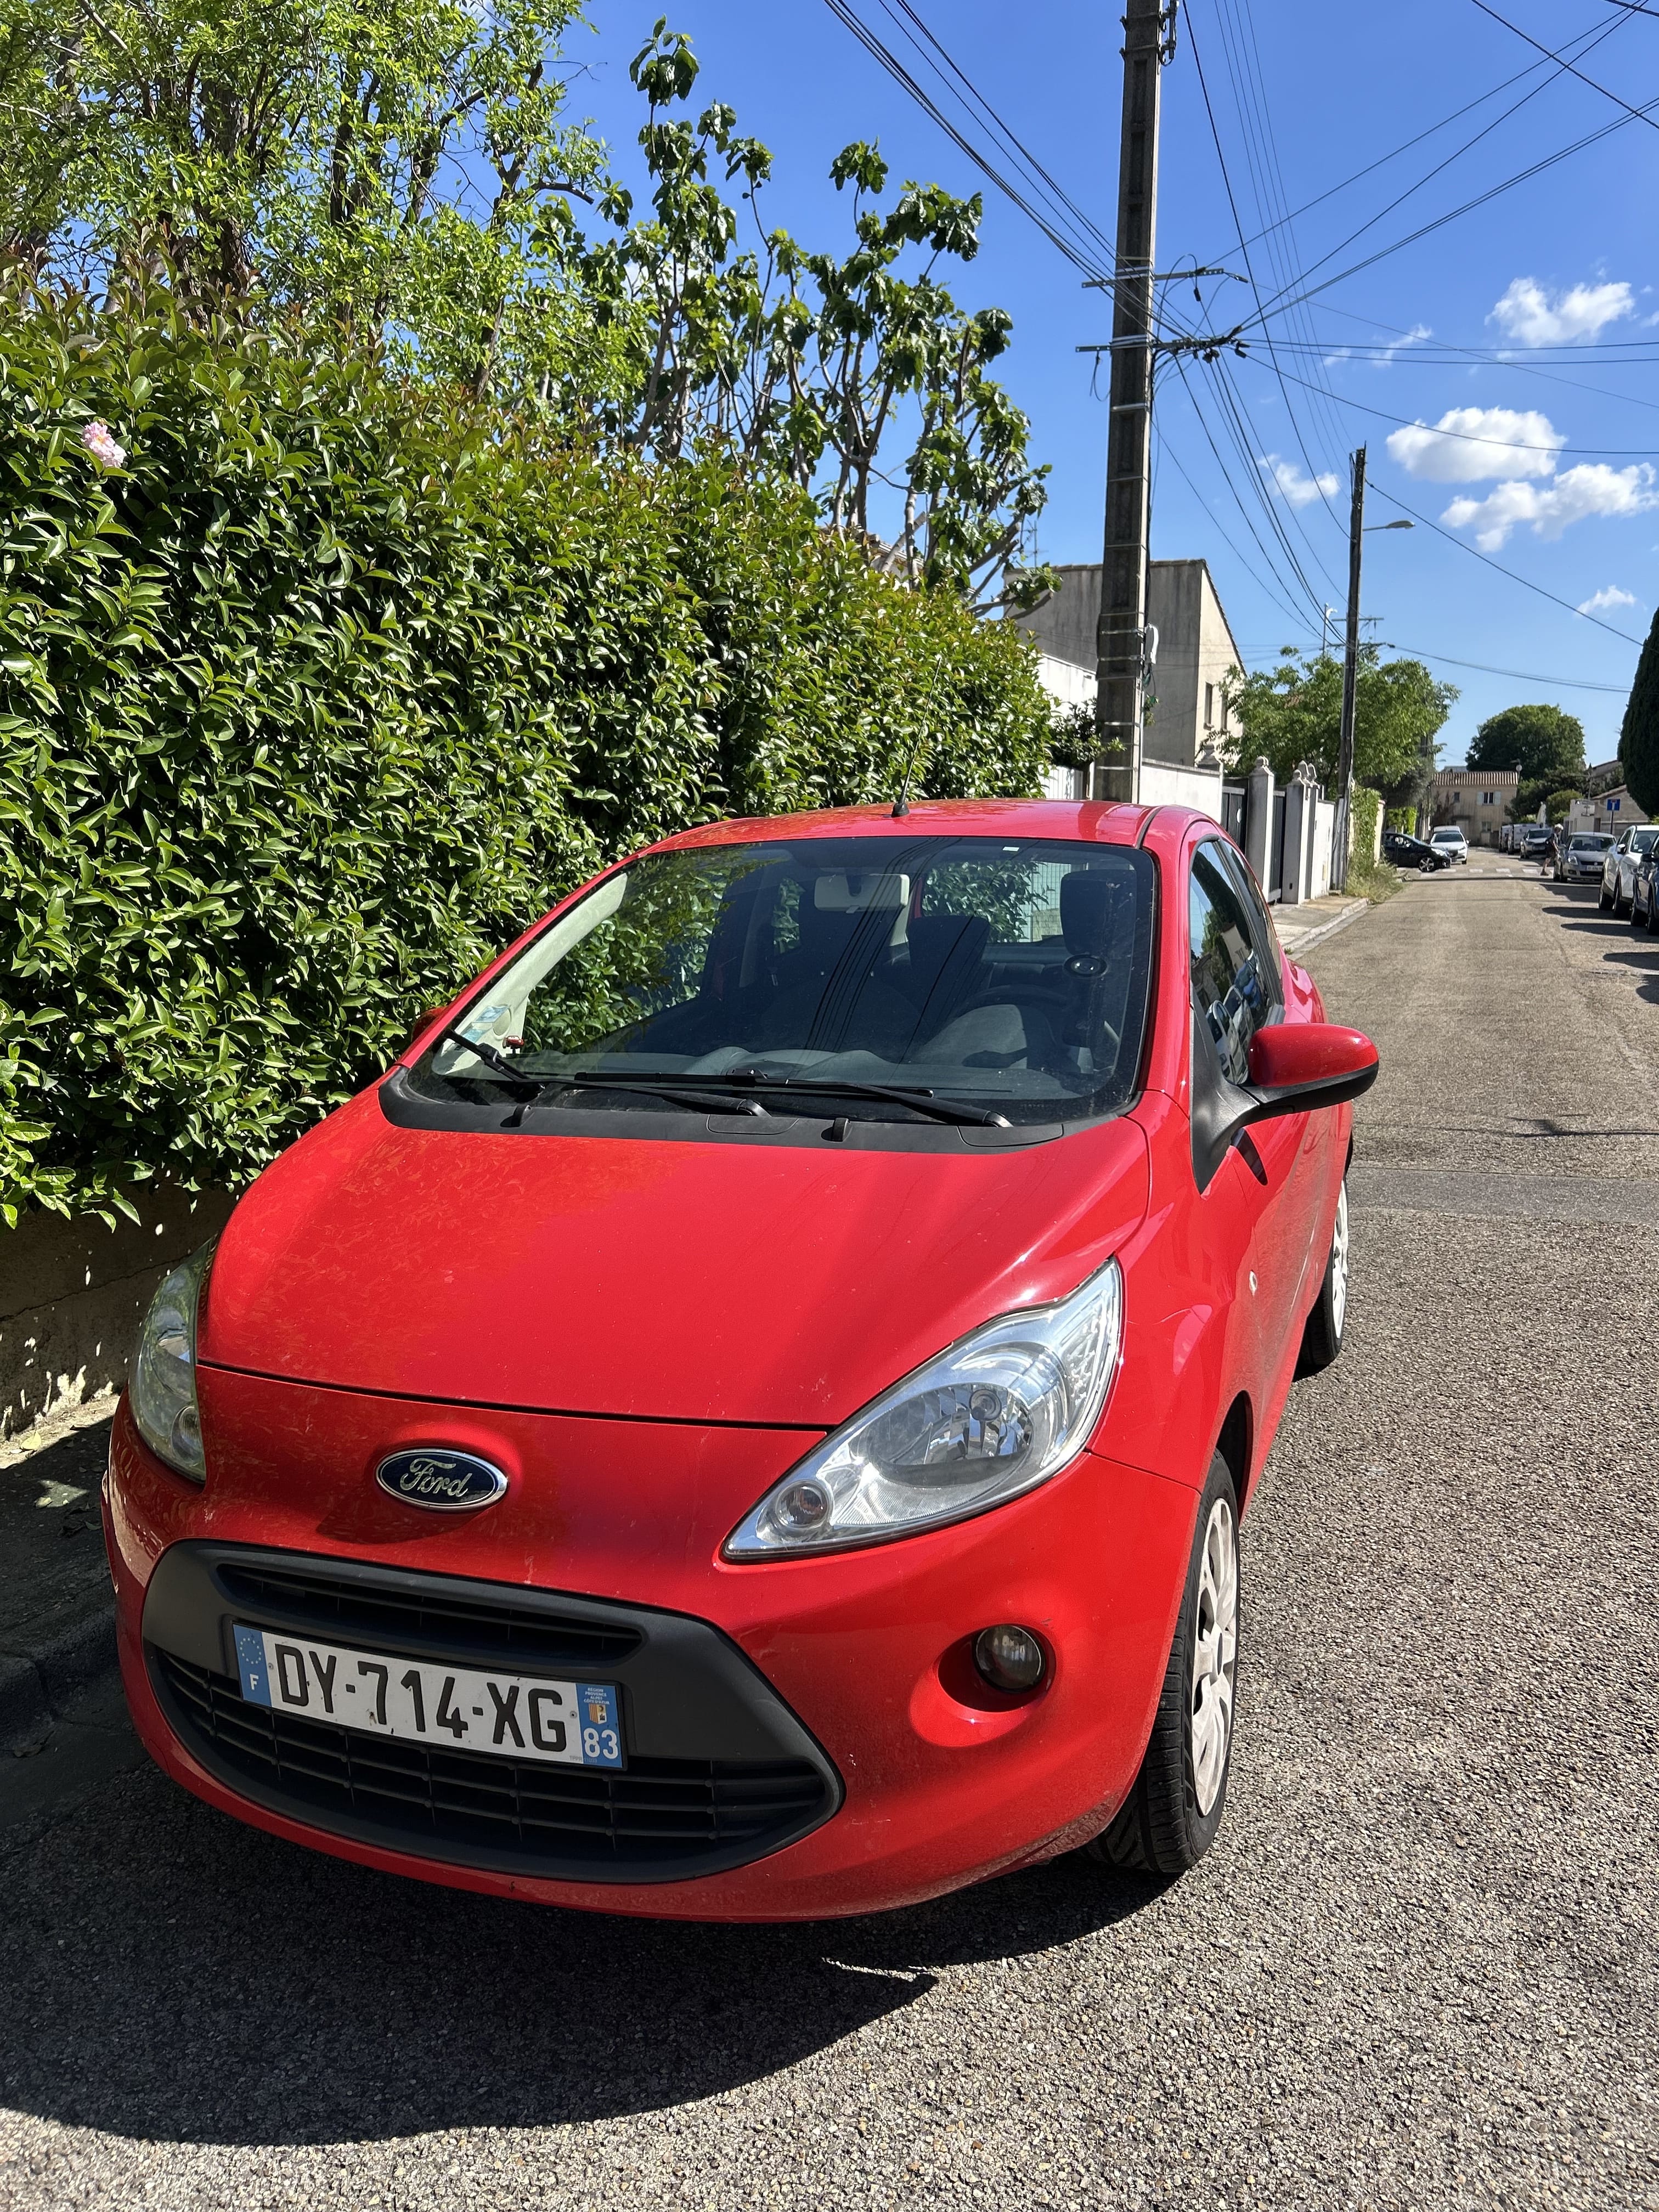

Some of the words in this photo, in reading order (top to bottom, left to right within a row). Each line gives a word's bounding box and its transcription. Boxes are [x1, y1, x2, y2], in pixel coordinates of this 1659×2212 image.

[399, 1457, 473, 1497] Ford
[250, 1673, 259, 1690] F
[274, 1643, 567, 1753] DY-714-XG
[583, 1727, 618, 1759] 83
